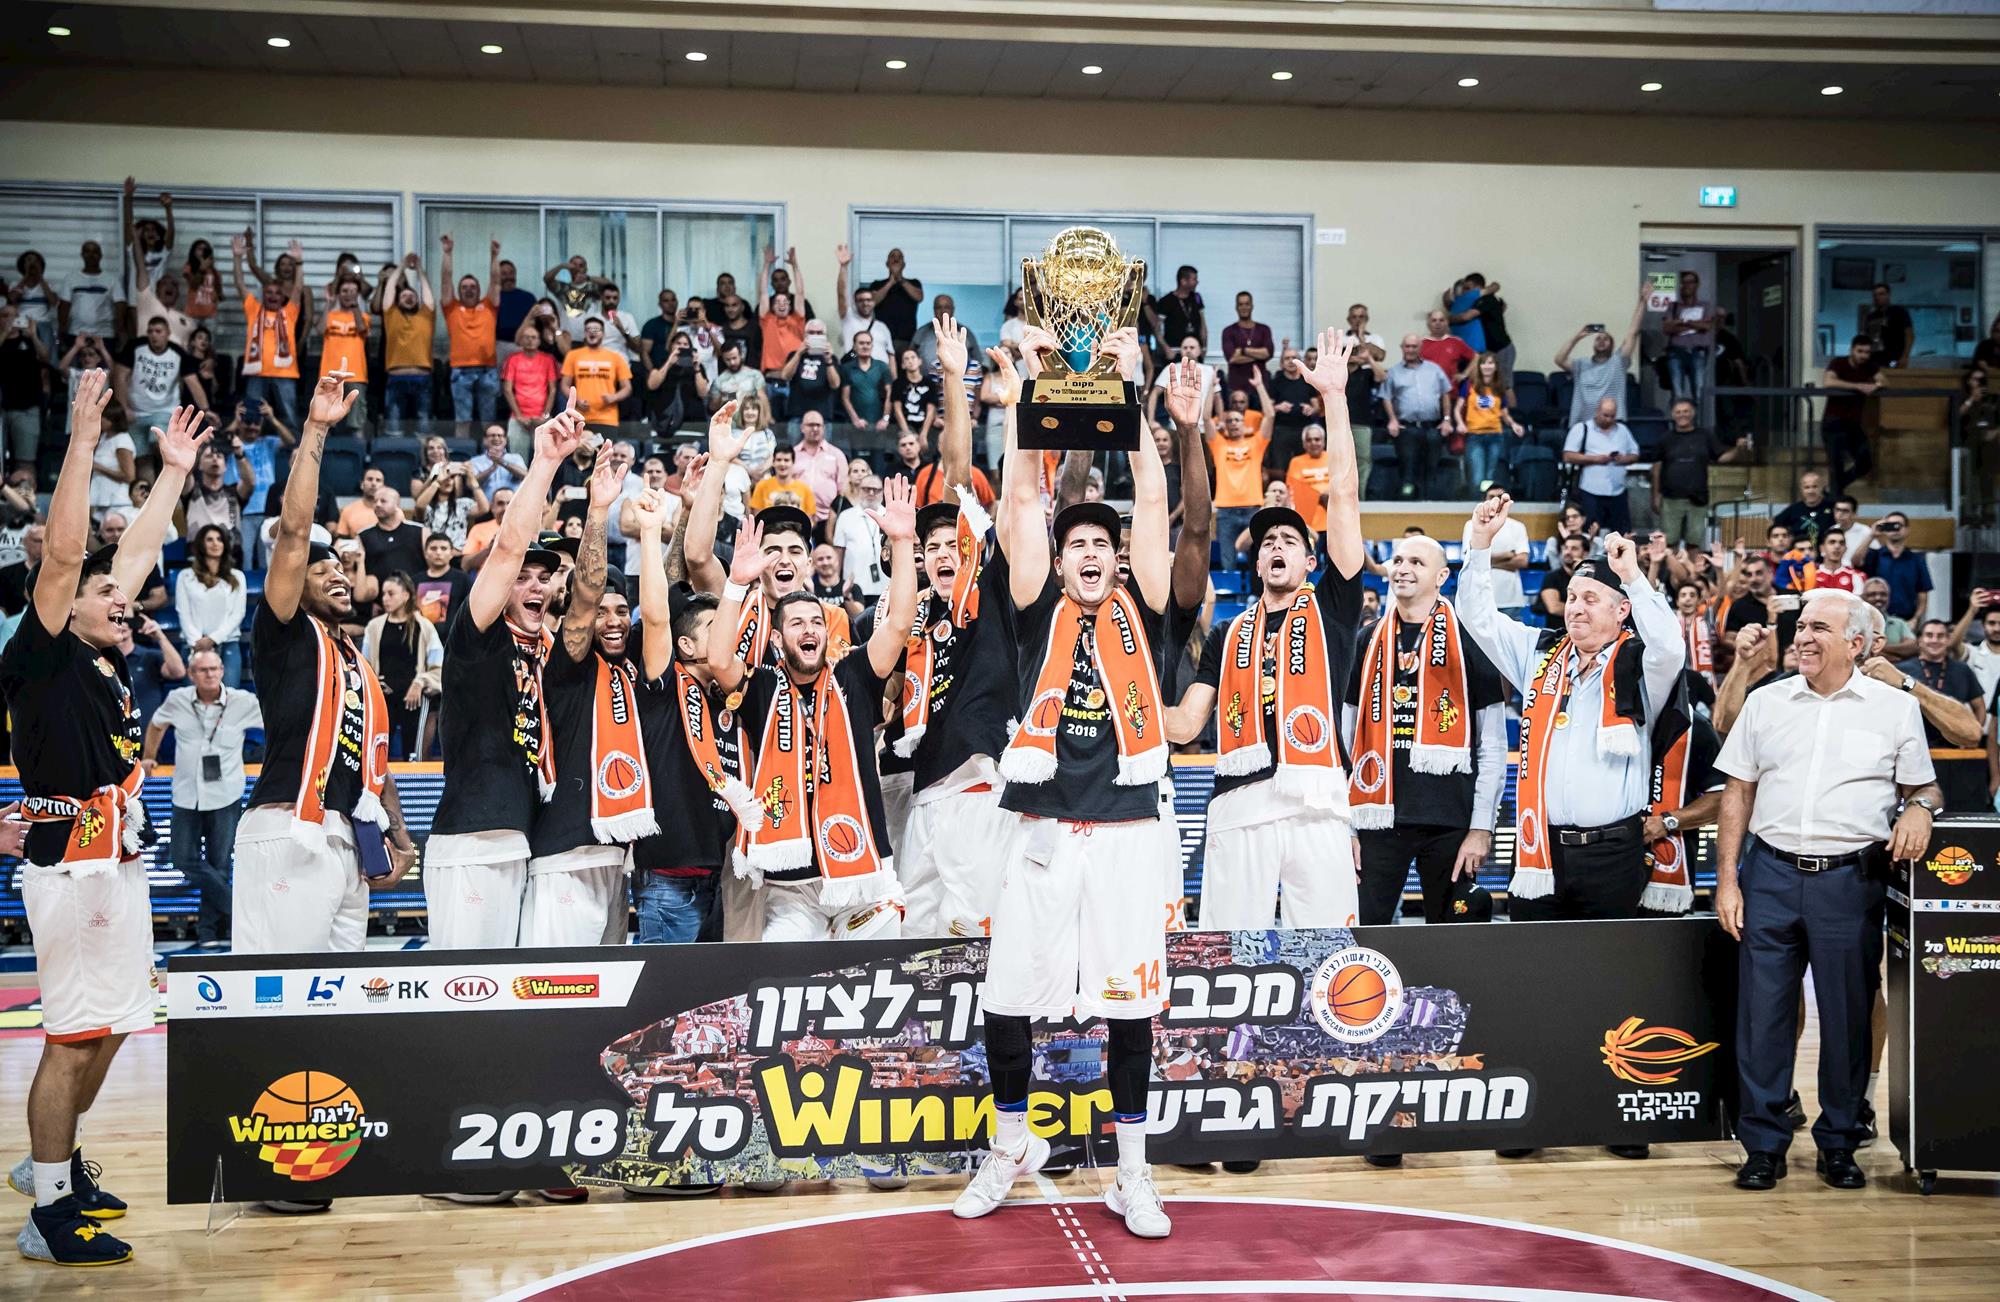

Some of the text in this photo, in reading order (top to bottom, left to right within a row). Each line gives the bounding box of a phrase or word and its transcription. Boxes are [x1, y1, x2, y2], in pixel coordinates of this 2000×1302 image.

[1291, 617, 1306, 674] 2018/19
[1432, 613, 1446, 666] 2018/19
[777, 693, 792, 751] מחזיקת
[1062, 707, 1106, 720] inner
[1066, 723, 1097, 737] 2018
[1926, 860, 1972, 872] Winner
[1924, 940, 1944, 953] סל
[1341, 953, 1371, 965] ראשון
[398, 980, 430, 999] RK
[453, 981, 490, 997] KIA
[530, 979, 596, 997] Winner
[1133, 959, 1160, 999] 14
[1167, 972, 1296, 1020] מכב
[1320, 1006, 1394, 1037] MACCABI RISHON LE ZION
[760, 1064, 1114, 1147] Winner
[1301, 1075, 1529, 1141] מחזיקת
[1617, 1089, 1700, 1107] מנהלת
[311, 1102, 356, 1123] ליגת
[653, 1092, 745, 1154] סל
[1622, 1104, 1695, 1122] הליגה
[228, 1115, 389, 1143] Winner סל
[451, 1108, 618, 1161] 2018
